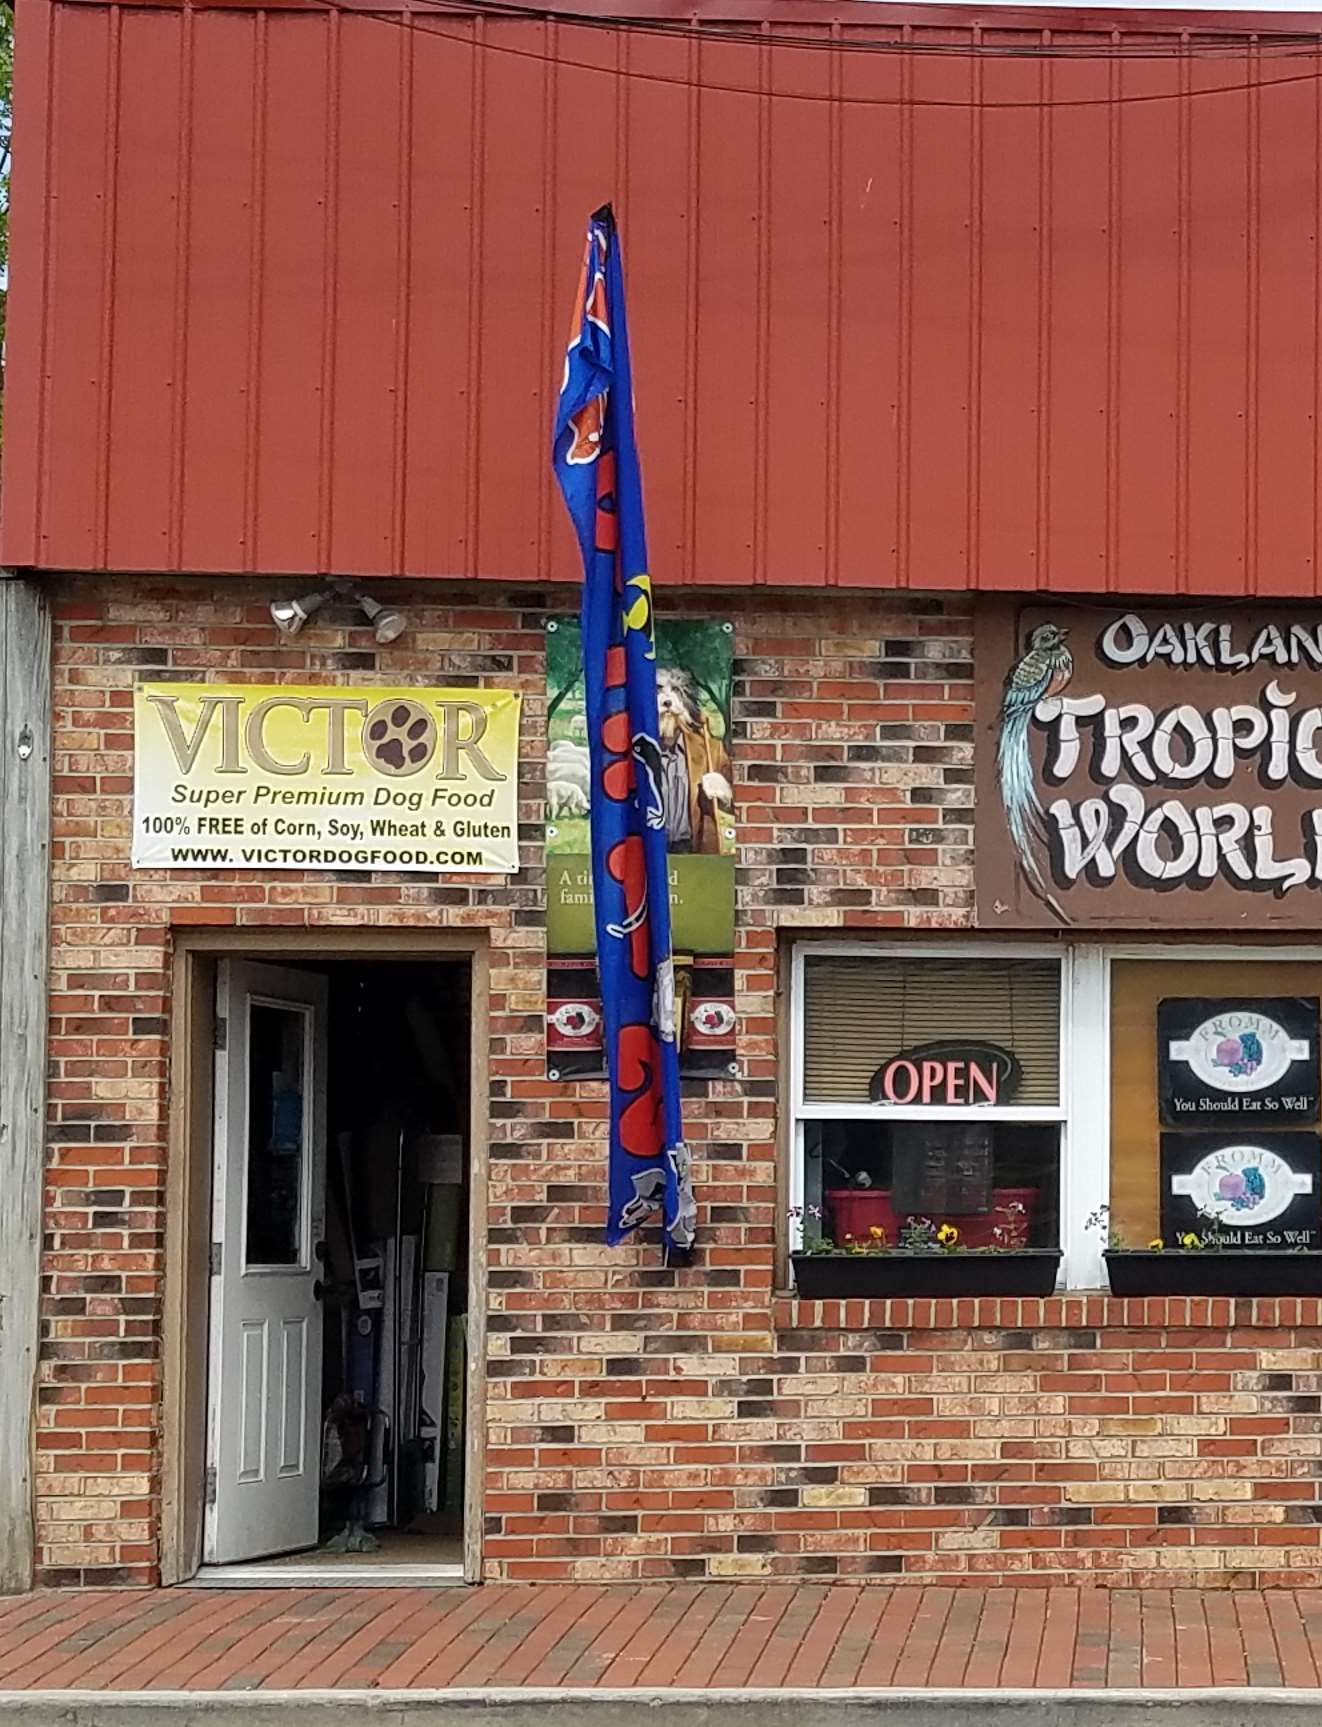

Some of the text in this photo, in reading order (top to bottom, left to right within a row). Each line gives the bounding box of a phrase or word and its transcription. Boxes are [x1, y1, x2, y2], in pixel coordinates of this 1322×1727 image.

[147, 693, 507, 782] VICTOR
[171, 784, 495, 811] Super Premium Dog Food
[142, 816, 511, 842] 100% FREE of Corn, Soy, Wheat & Gluten
[559, 869, 572, 886] A
[1198, 1015, 1281, 1042] FROMM
[883, 1060, 998, 1105] OPEN
[1174, 1098, 1196, 1112] You
[1199, 1096, 1239, 1111] Should
[1242, 1098, 1262, 1111] Eat
[1264, 1097, 1279, 1111] So
[1201, 1150, 1283, 1176] FROMM
[1244, 1232, 1264, 1245] Eat
[1266, 1231, 1282, 1245] So
